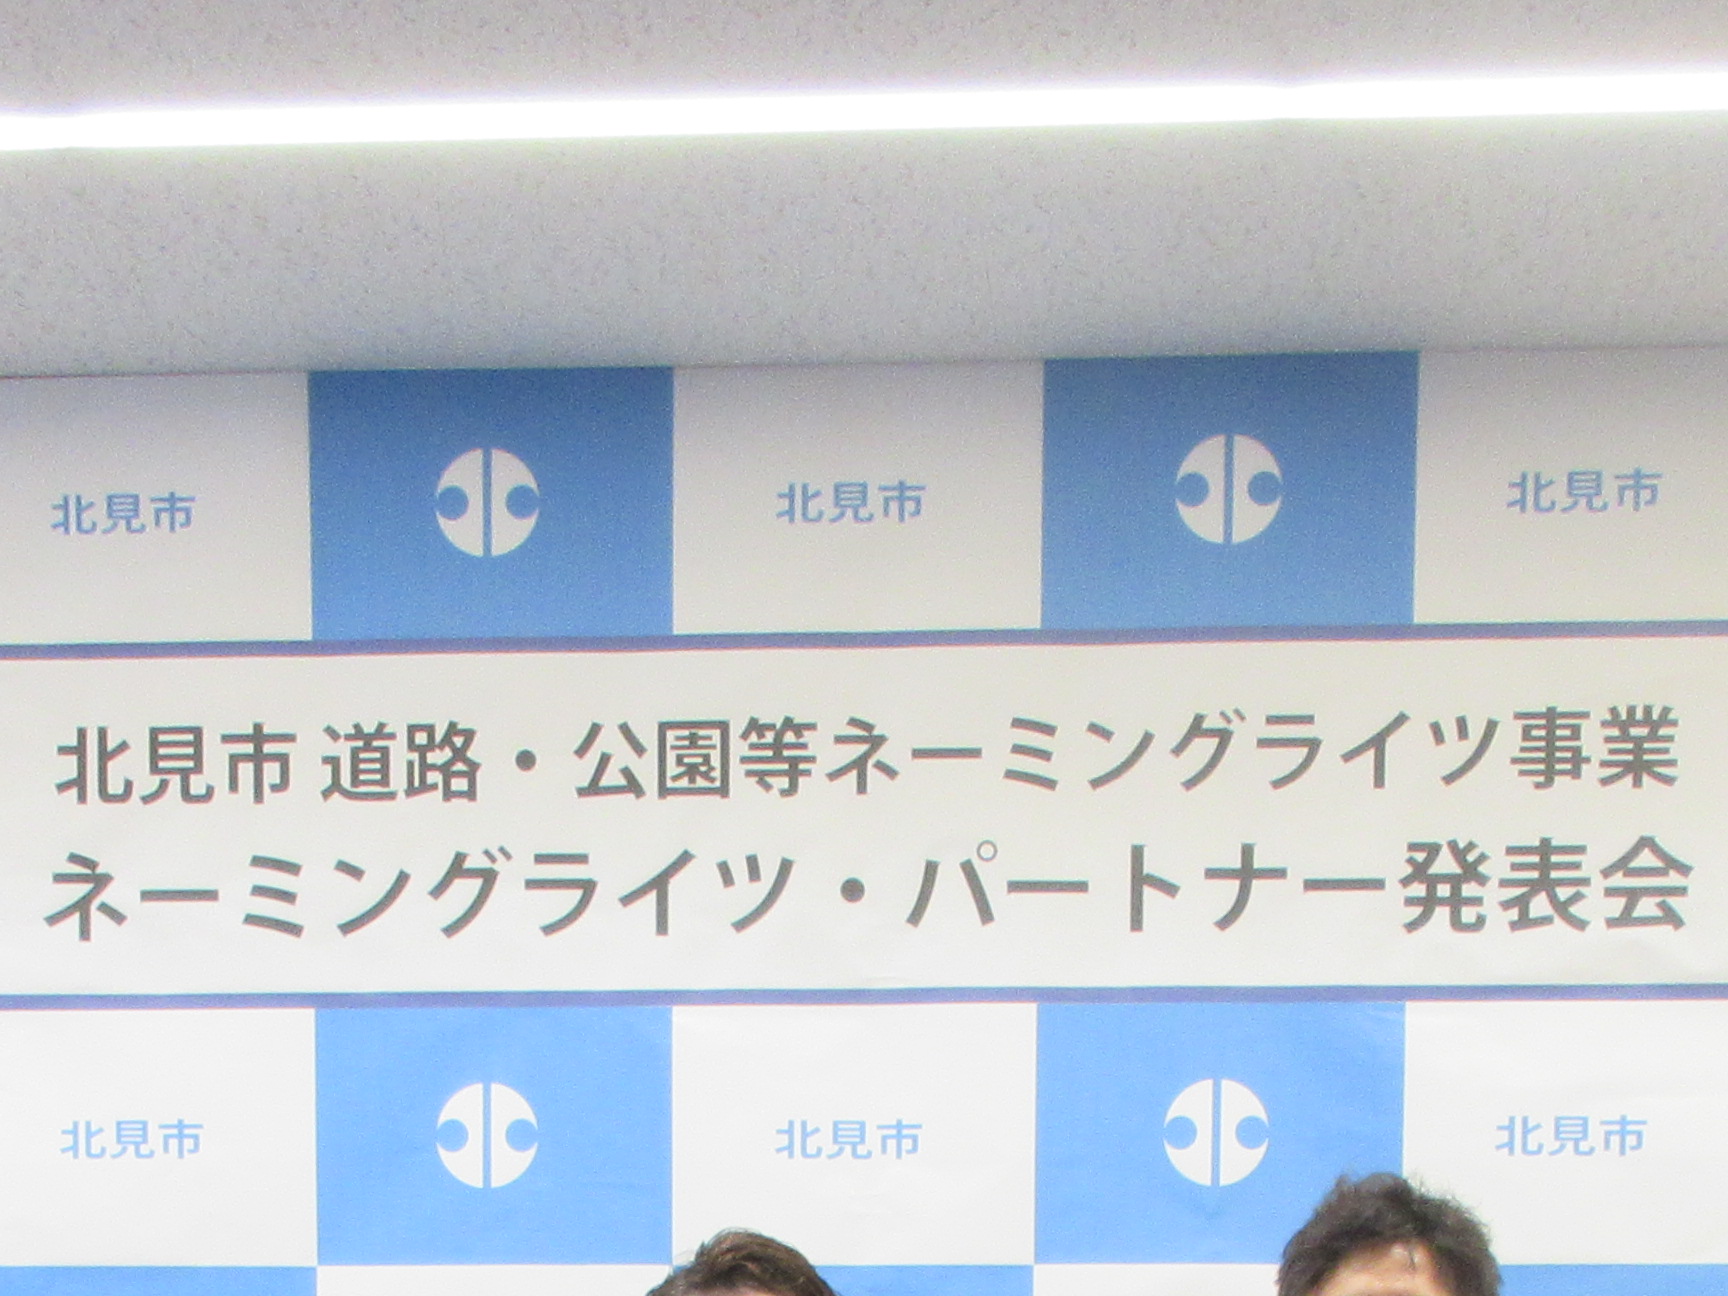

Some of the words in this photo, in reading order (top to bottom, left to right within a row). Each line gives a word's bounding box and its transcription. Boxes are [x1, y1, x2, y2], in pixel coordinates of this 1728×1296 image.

[51, 491, 196, 536] 北見市
[775, 480, 926, 526] 北見市
[1506, 467, 1664, 515] 北見市
[55, 723, 300, 806] 北見市
[42, 834, 1695, 944] ネーミングライツ・パートナー発表会
[59, 1118, 204, 1161] 北見市
[774, 1118, 924, 1161] 北見市
[1494, 1114, 1648, 1157] 北見市
